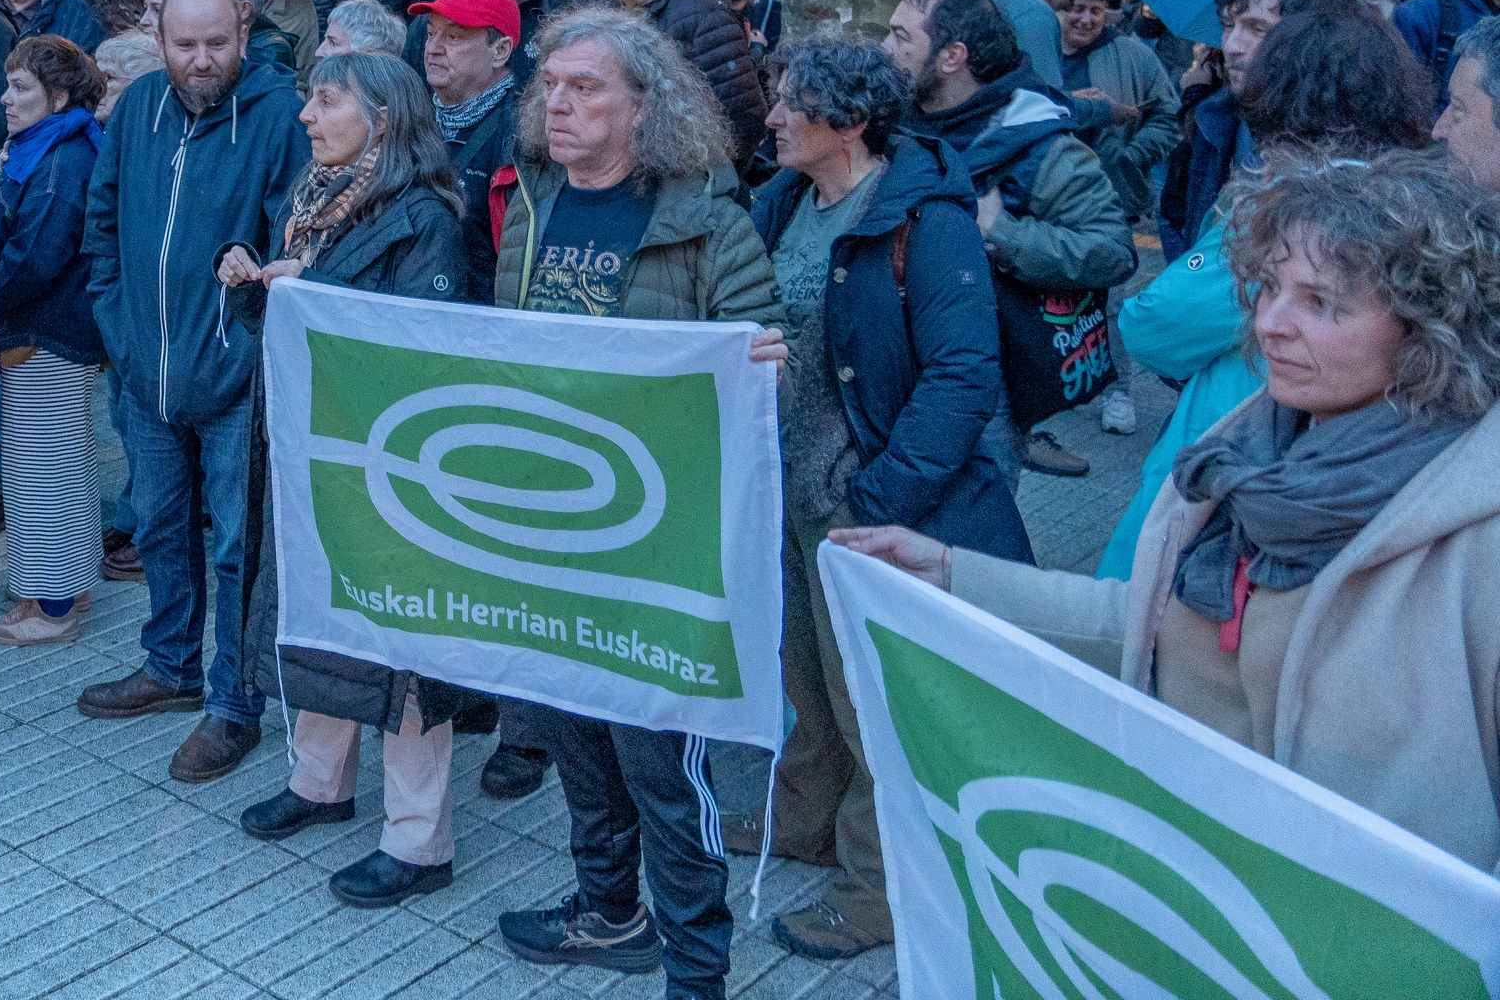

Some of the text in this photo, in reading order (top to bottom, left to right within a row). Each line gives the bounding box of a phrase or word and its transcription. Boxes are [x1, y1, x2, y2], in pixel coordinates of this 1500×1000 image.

[339, 572, 719, 686] Euskal Herrian Euskaraz
